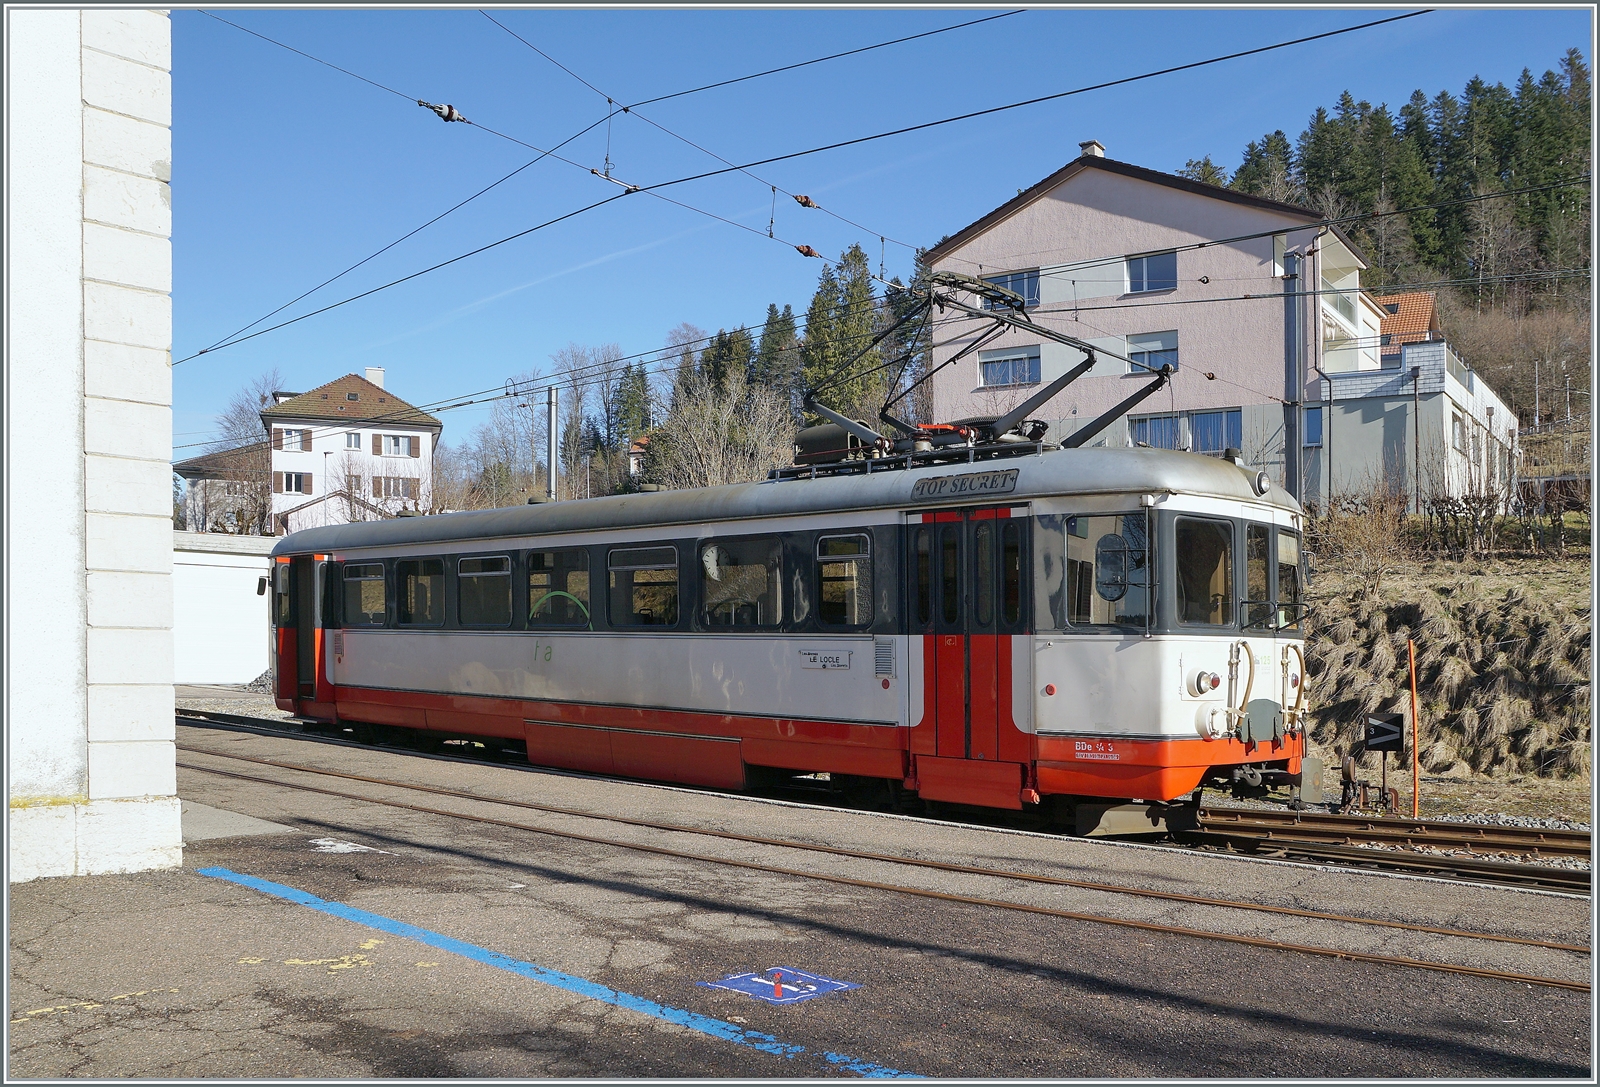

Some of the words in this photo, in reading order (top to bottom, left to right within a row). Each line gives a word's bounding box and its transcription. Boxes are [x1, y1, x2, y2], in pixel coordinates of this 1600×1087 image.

[918, 480, 948, 496] TOP
[950, 473, 1012, 494] SECRET
[1369, 727, 1375, 735] 3
[1075, 741, 1092, 751] BDe
